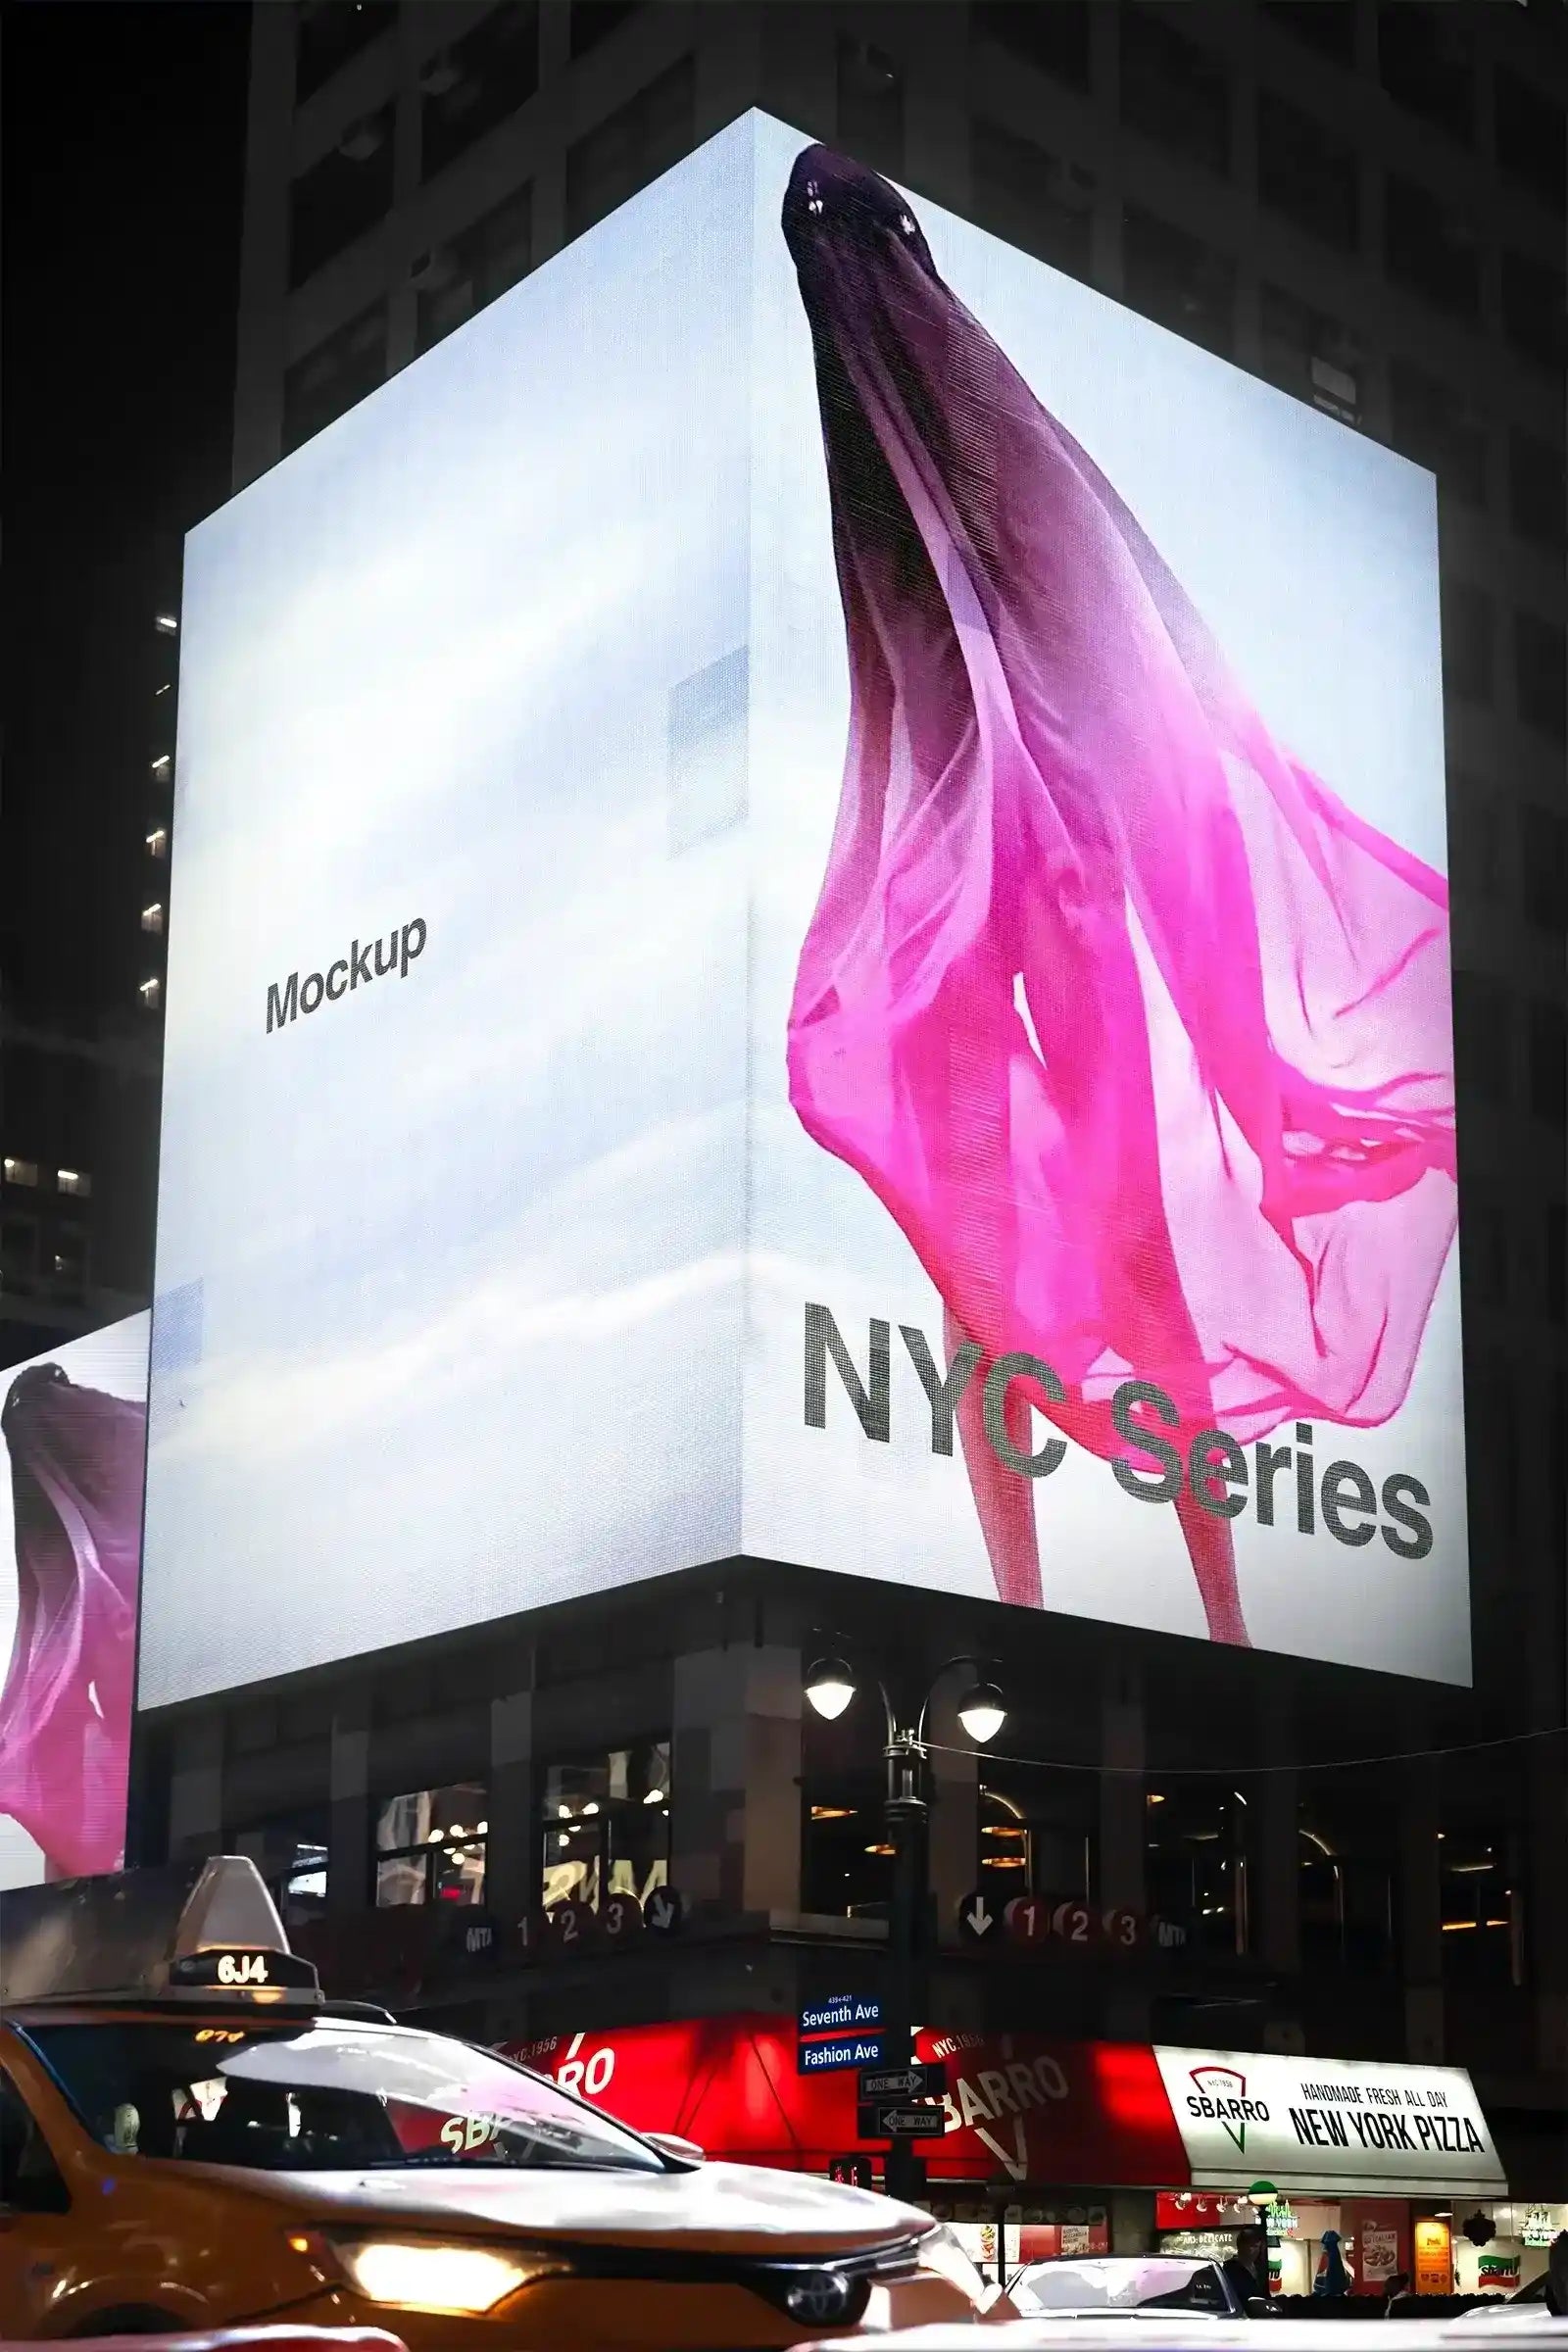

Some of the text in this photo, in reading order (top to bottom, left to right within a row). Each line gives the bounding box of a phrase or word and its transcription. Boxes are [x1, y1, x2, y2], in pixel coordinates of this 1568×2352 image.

[267, 917, 427, 1035] Mockup
[804, 1300, 1435, 1560] NYC Series
[516, 1916, 528, 1947] 1
[560, 1909, 578, 1943] 2
[606, 1902, 624, 1935] 3
[1022, 1905, 1035, 1936] 1
[1070, 1910, 1089, 1942] 2
[1120, 1914, 1137, 1946] 3
[217, 1954, 269, 1984] 6J4
[802, 2003, 879, 2027] Seventh Ave
[804, 2043, 879, 2066] Fashion Ave
[870, 2074, 917, 2090] ONE WAY
[912, 2054, 1069, 2133] BARRO
[1300, 2082, 1448, 2109] HANDMADE FRESH ALL DAY
[888, 2115, 933, 2127] ONE WAY
[1186, 2095, 1270, 2122] SBARRO
[1288, 2107, 1486, 2153] NEW YORK PIZZA
